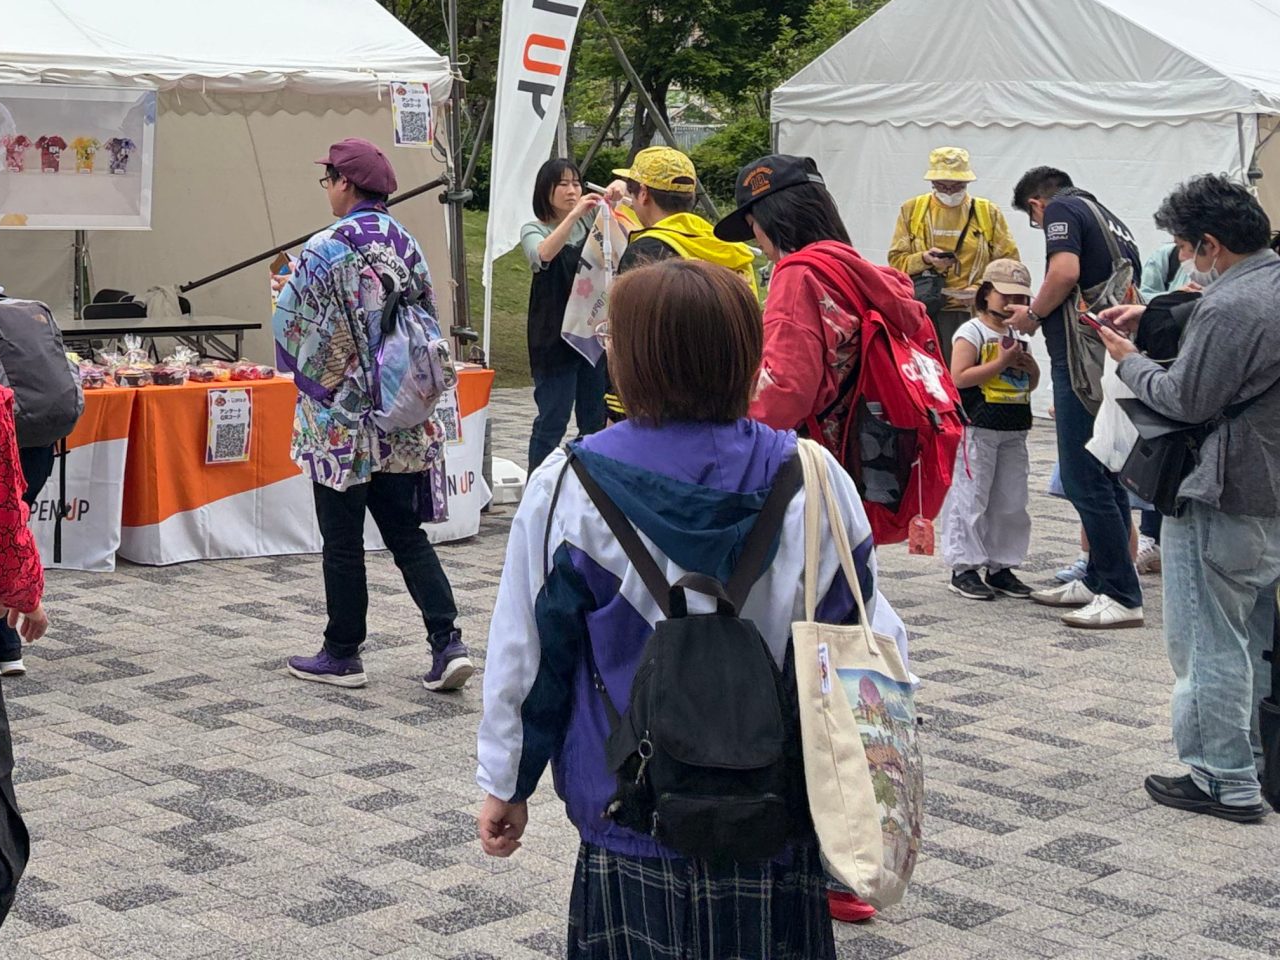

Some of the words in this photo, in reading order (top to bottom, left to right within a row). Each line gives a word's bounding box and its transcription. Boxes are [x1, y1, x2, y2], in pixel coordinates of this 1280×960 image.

[517, 33, 567, 121] UP
[460, 470, 475, 495] UP
[28, 499, 62, 521] PEN
